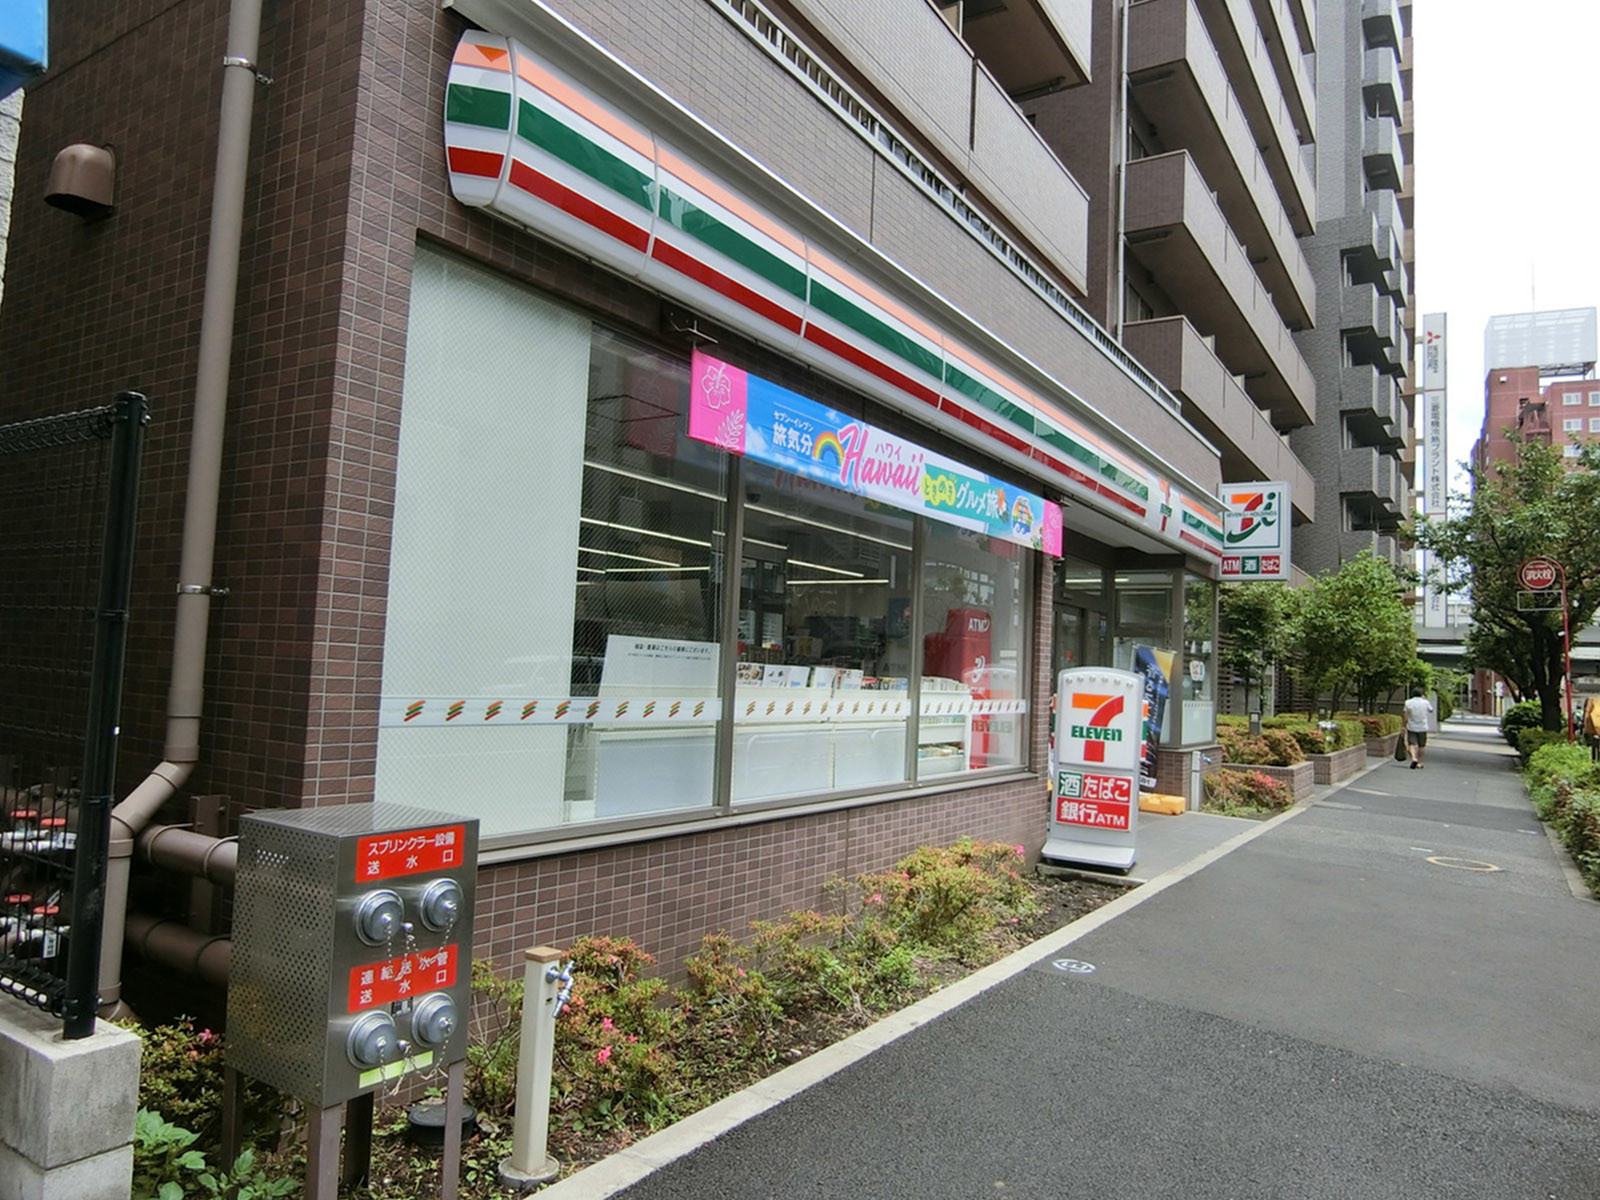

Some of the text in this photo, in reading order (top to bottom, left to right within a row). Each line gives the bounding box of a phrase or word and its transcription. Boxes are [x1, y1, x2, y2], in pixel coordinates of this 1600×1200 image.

[772, 422, 813, 456] 旅気分
[838, 424, 924, 496] Hawaii
[875, 441, 902, 461] ハワイ
[956, 481, 1000, 519] グルメ旅
[1222, 560, 1240, 572] ATM
[1244, 559, 1257, 572] 酒
[1261, 559, 1280, 571] たばこ
[1525, 568, 1552, 580] 消火栓
[968, 617, 987, 632] ATM
[1072, 693, 1125, 763] 7
[1060, 774, 1081, 797] 酒
[1084, 777, 1129, 801] たばこ
[367, 831, 455, 857] スプリンクラー設備
